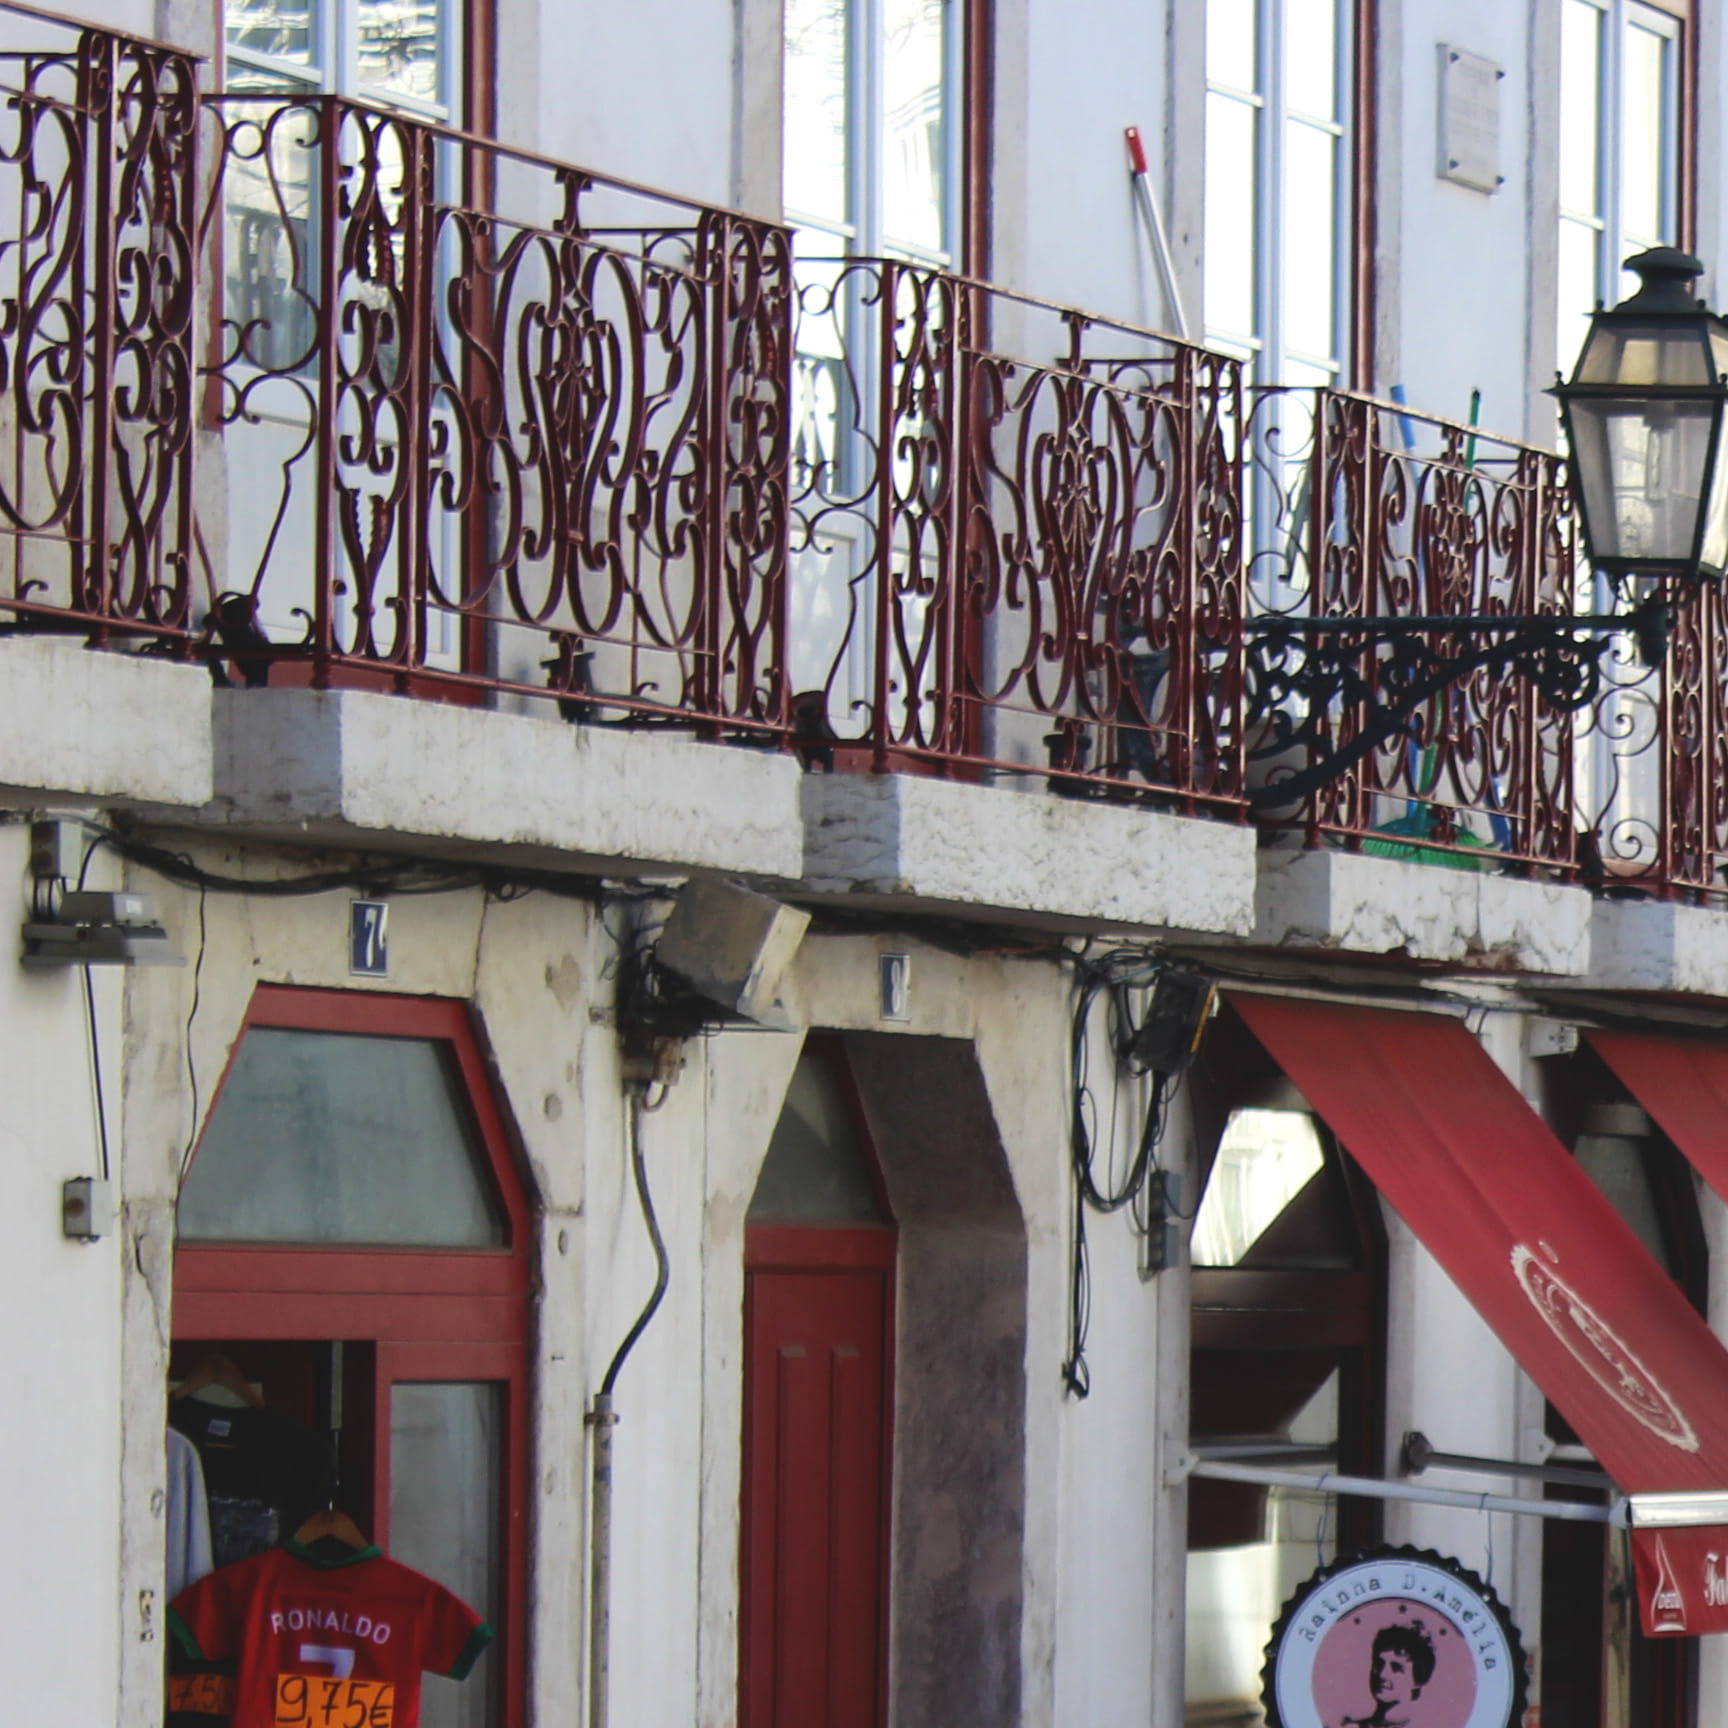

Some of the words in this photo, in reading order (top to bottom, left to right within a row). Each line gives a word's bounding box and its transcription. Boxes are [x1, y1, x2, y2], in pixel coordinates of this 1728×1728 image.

[364, 908, 378, 969] 7
[270, 1608, 392, 1645] RONALDO
[1299, 1576, 1383, 1643] Rainha
